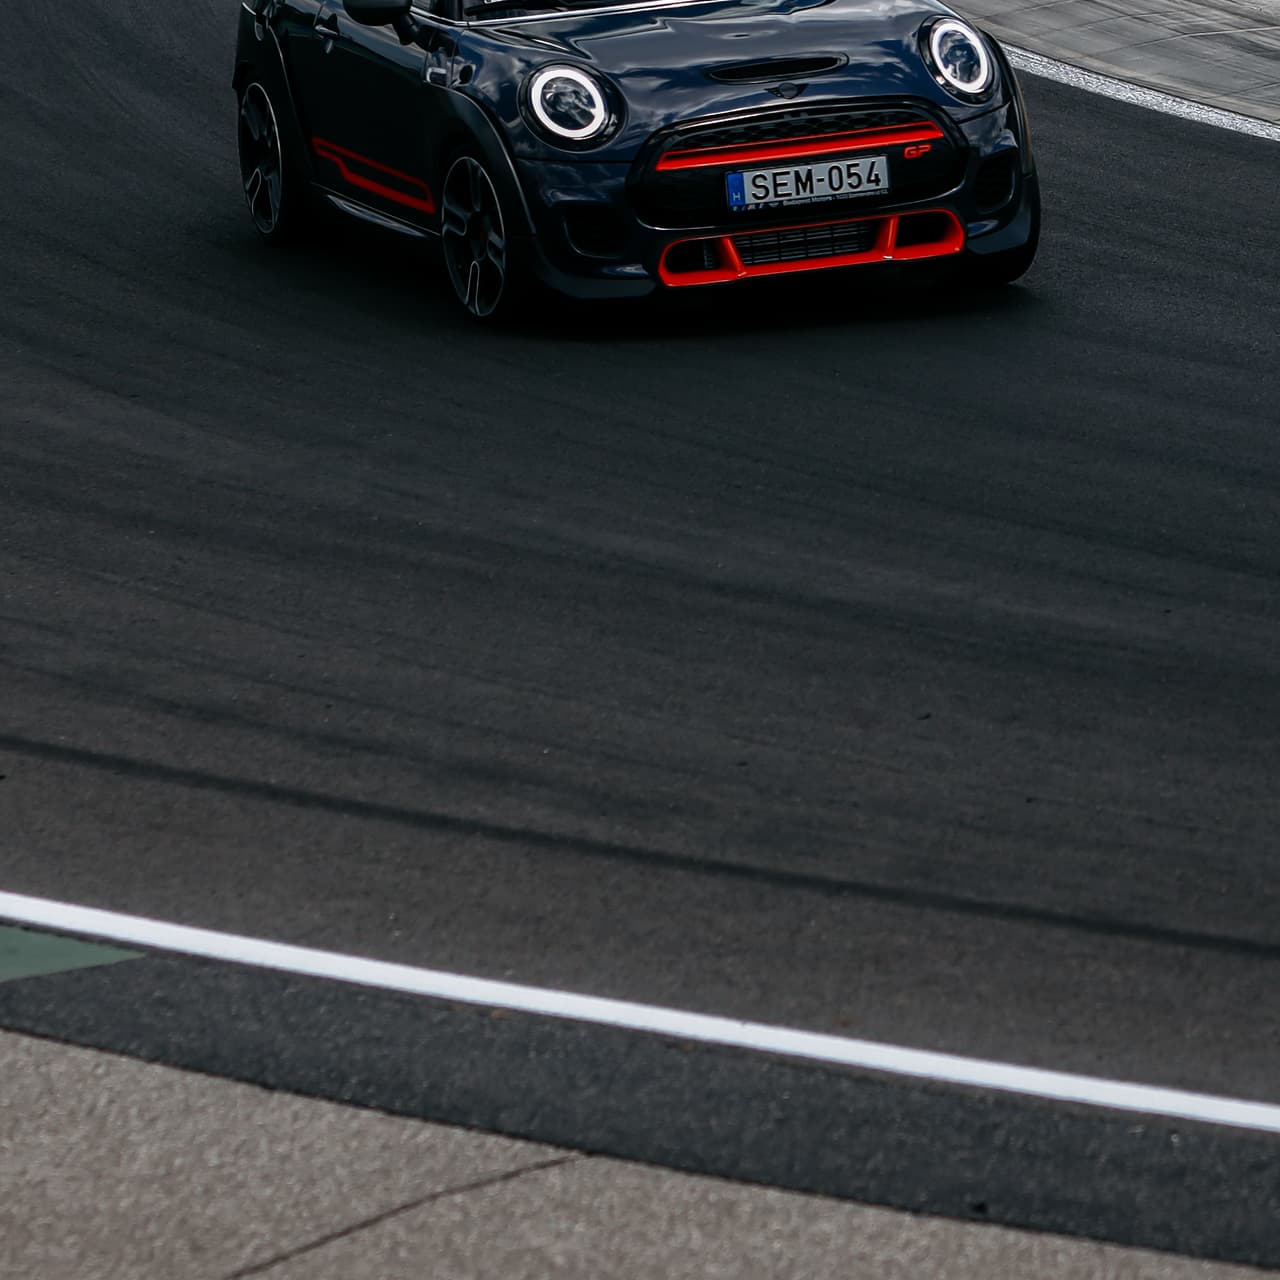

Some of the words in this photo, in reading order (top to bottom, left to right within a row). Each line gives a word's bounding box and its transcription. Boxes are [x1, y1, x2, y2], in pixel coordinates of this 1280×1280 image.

[904, 144, 932, 159] GP
[732, 192, 741, 201] H
[752, 161, 881, 200] SEM-054
